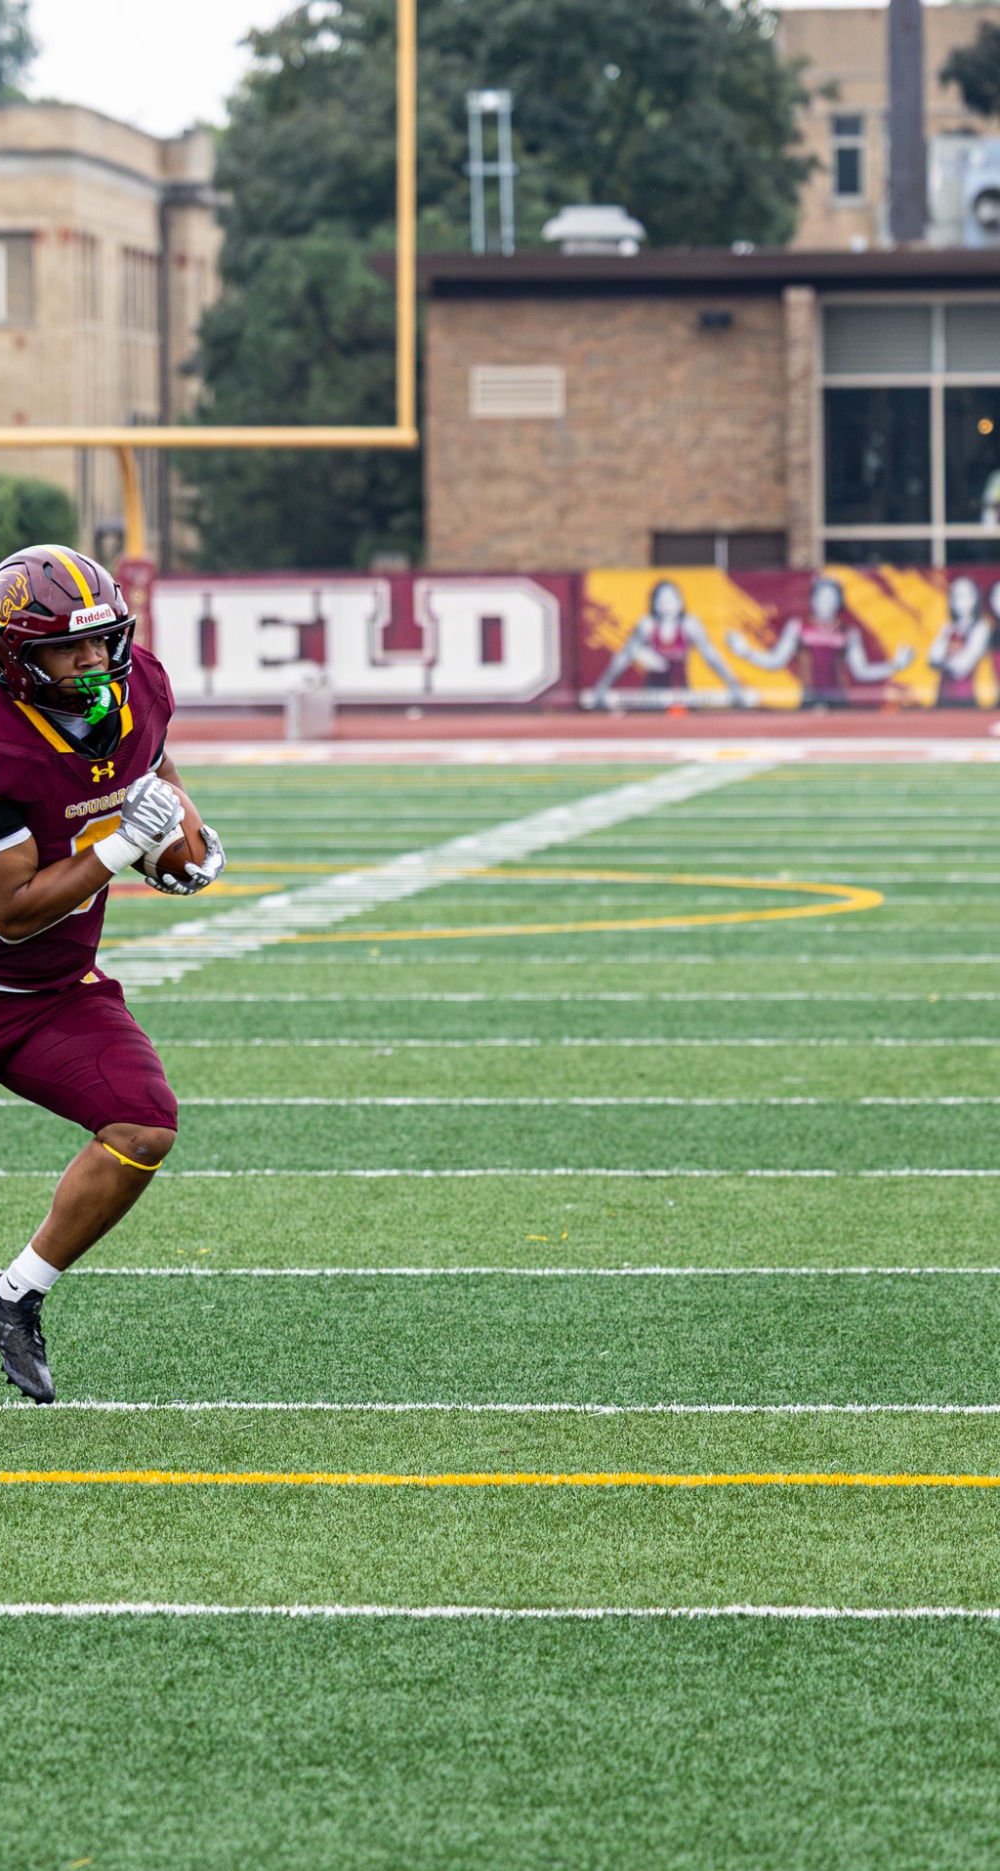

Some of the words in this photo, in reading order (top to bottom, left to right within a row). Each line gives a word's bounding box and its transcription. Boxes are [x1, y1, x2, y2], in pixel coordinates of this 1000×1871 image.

[75, 608, 113, 625] Riddell
[151, 577, 560, 705] IELD
[65, 785, 131, 819] COUGAR
